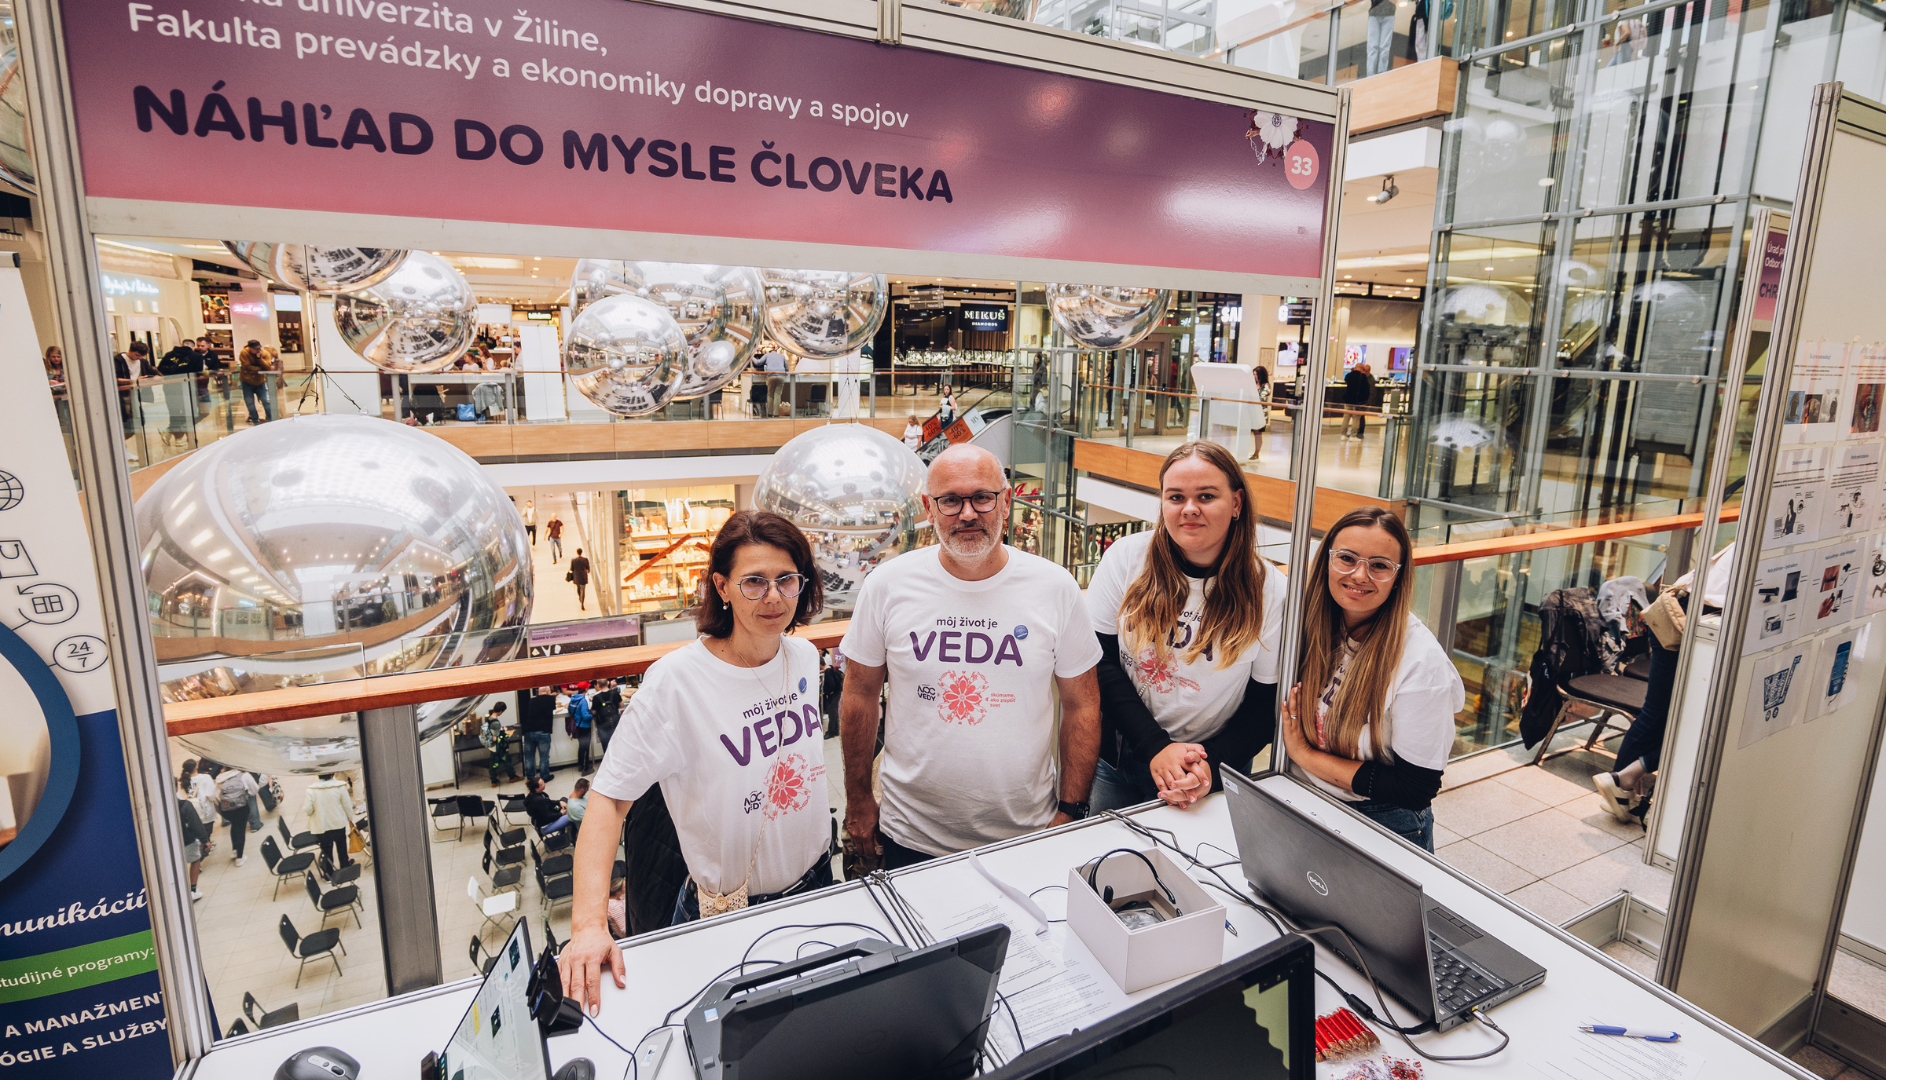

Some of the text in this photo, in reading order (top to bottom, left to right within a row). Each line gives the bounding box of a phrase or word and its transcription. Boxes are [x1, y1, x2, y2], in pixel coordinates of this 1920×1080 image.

[485, 18, 502, 38] v
[513, 9, 607, 57] Žiline,
[128, 2, 909, 130] Fakulta prevádzky a ekonomiky dopravy a spojov
[133, 80, 953, 203] NÁHĽAD DO MYSLE ČLOVEKA
[1291, 155, 1313, 176] 33
[964, 309, 1005, 320] MIKUŠ
[664, 497, 693, 523] YES
[936, 616, 998, 629] môj život je
[68, 641, 90, 655] 24
[78, 657, 87, 668] 7
[909, 631, 1023, 667] VEDA
[743, 704, 764, 719] môj
[789, 692, 798, 705] je
[720, 703, 823, 766] VEDA
[0, 947, 155, 988] tudijné programy:
[5, 991, 163, 1038] A MANAŽMEN
[0, 1018, 167, 1066] ÓGIE A SLUŽBY
